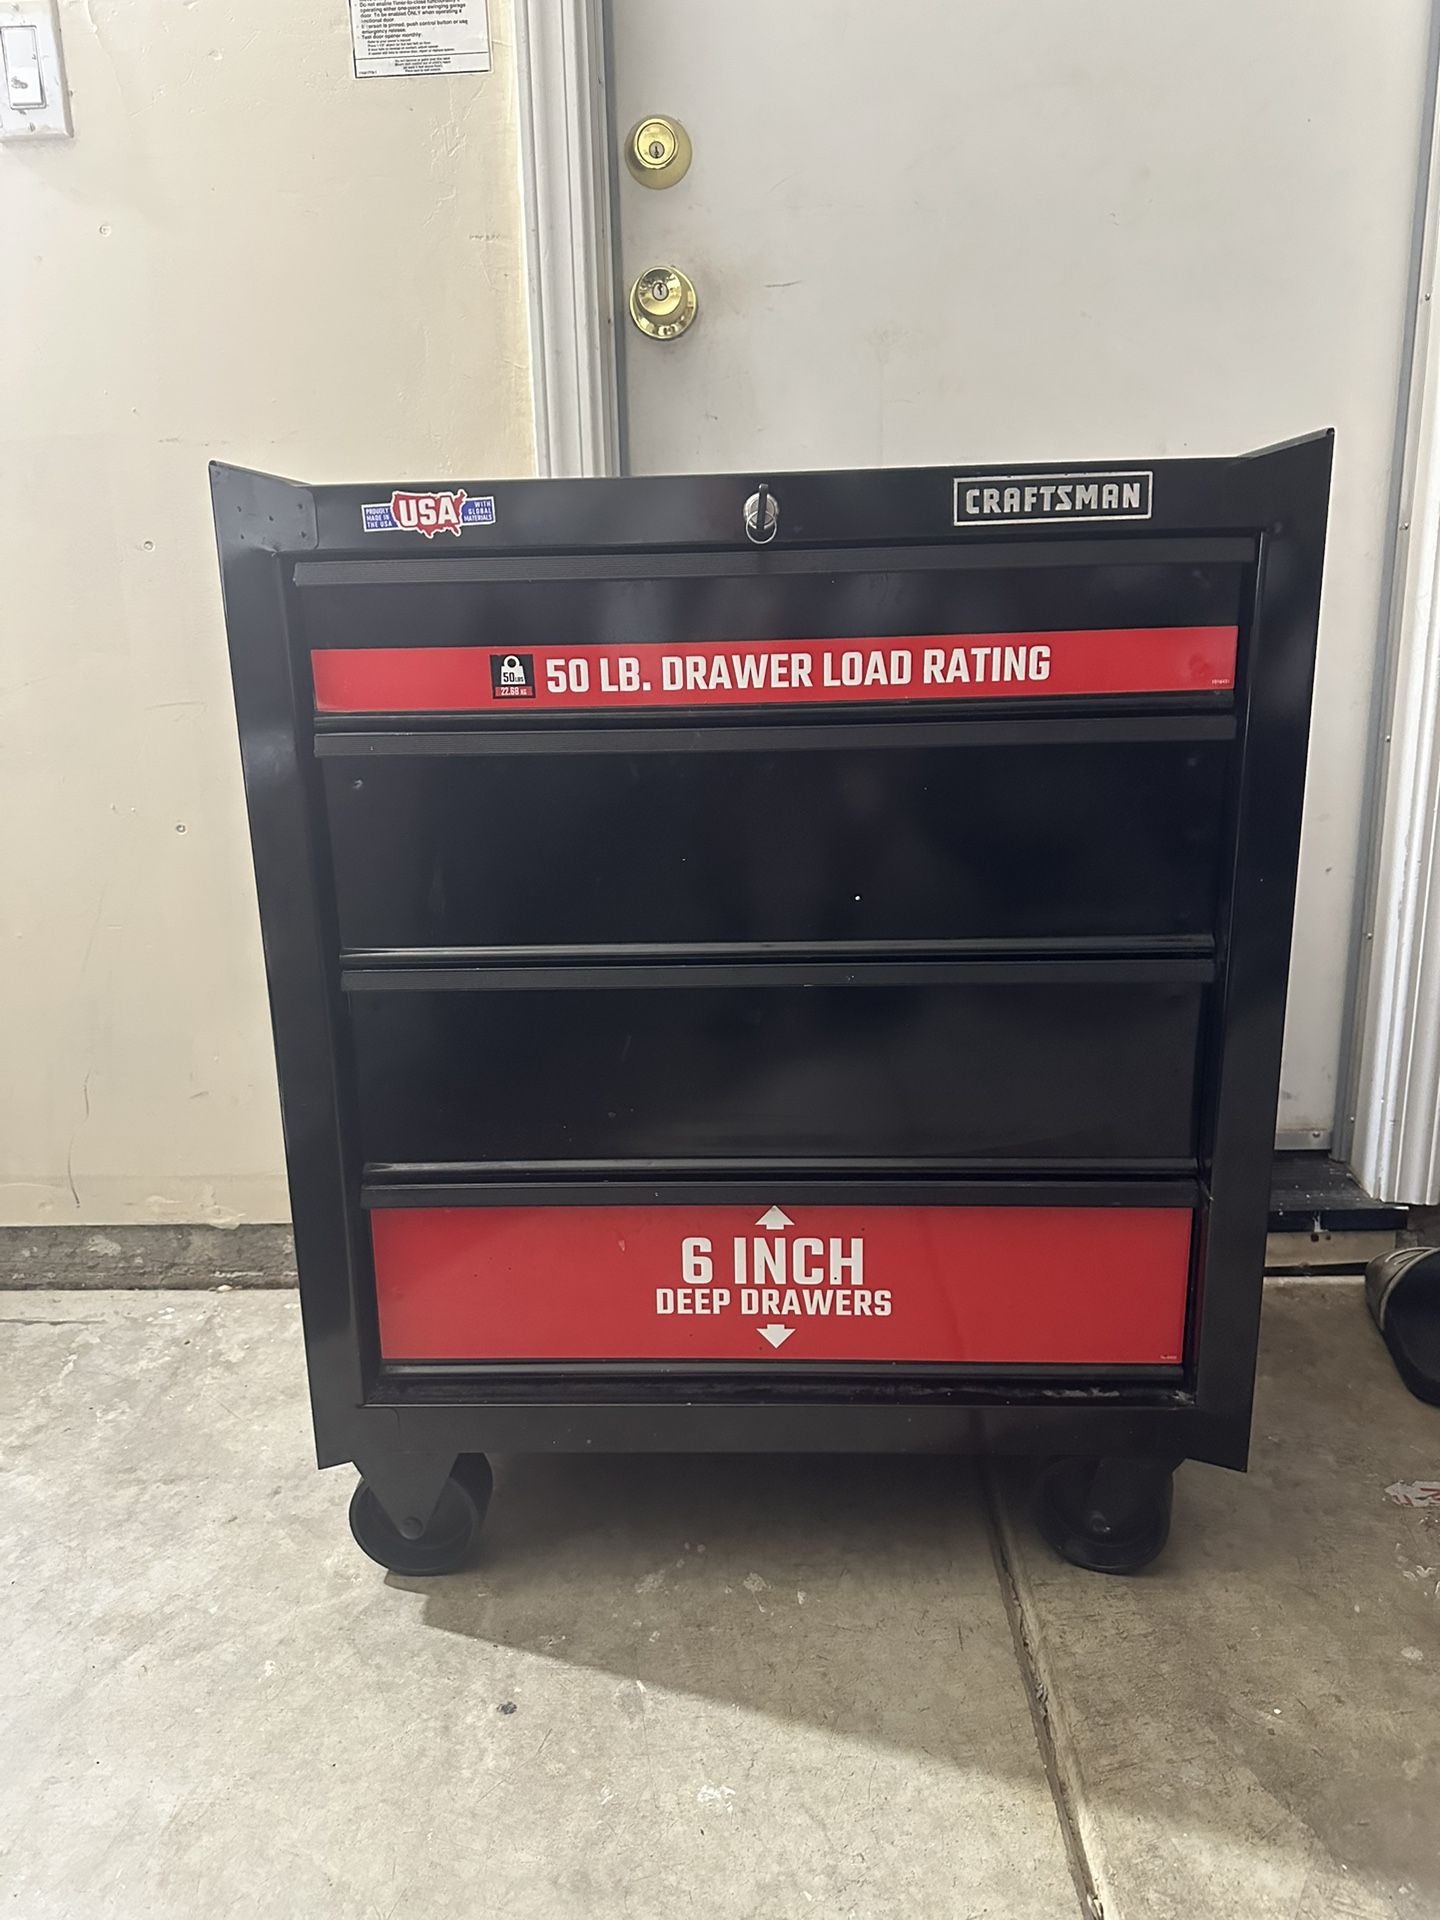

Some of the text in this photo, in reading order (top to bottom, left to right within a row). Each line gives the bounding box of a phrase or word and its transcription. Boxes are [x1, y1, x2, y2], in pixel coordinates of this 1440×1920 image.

[966, 482, 1140, 514] CRAFTSMAN
[474, 500, 491, 508] WITH
[366, 507, 390, 515] PROUDLY
[399, 496, 460, 528] USA
[468, 507, 492, 515] GLOBAL
[463, 513, 493, 522] MATERIALS
[367, 519, 393, 529] THE USA
[546, 645, 1051, 693] 50 LB. DRAWER LOAD RATING
[500, 687, 519, 696] 22.68
[681, 1236, 864, 1285] 6 INCH
[656, 1288, 892, 1317] DEEP DRAWERS
